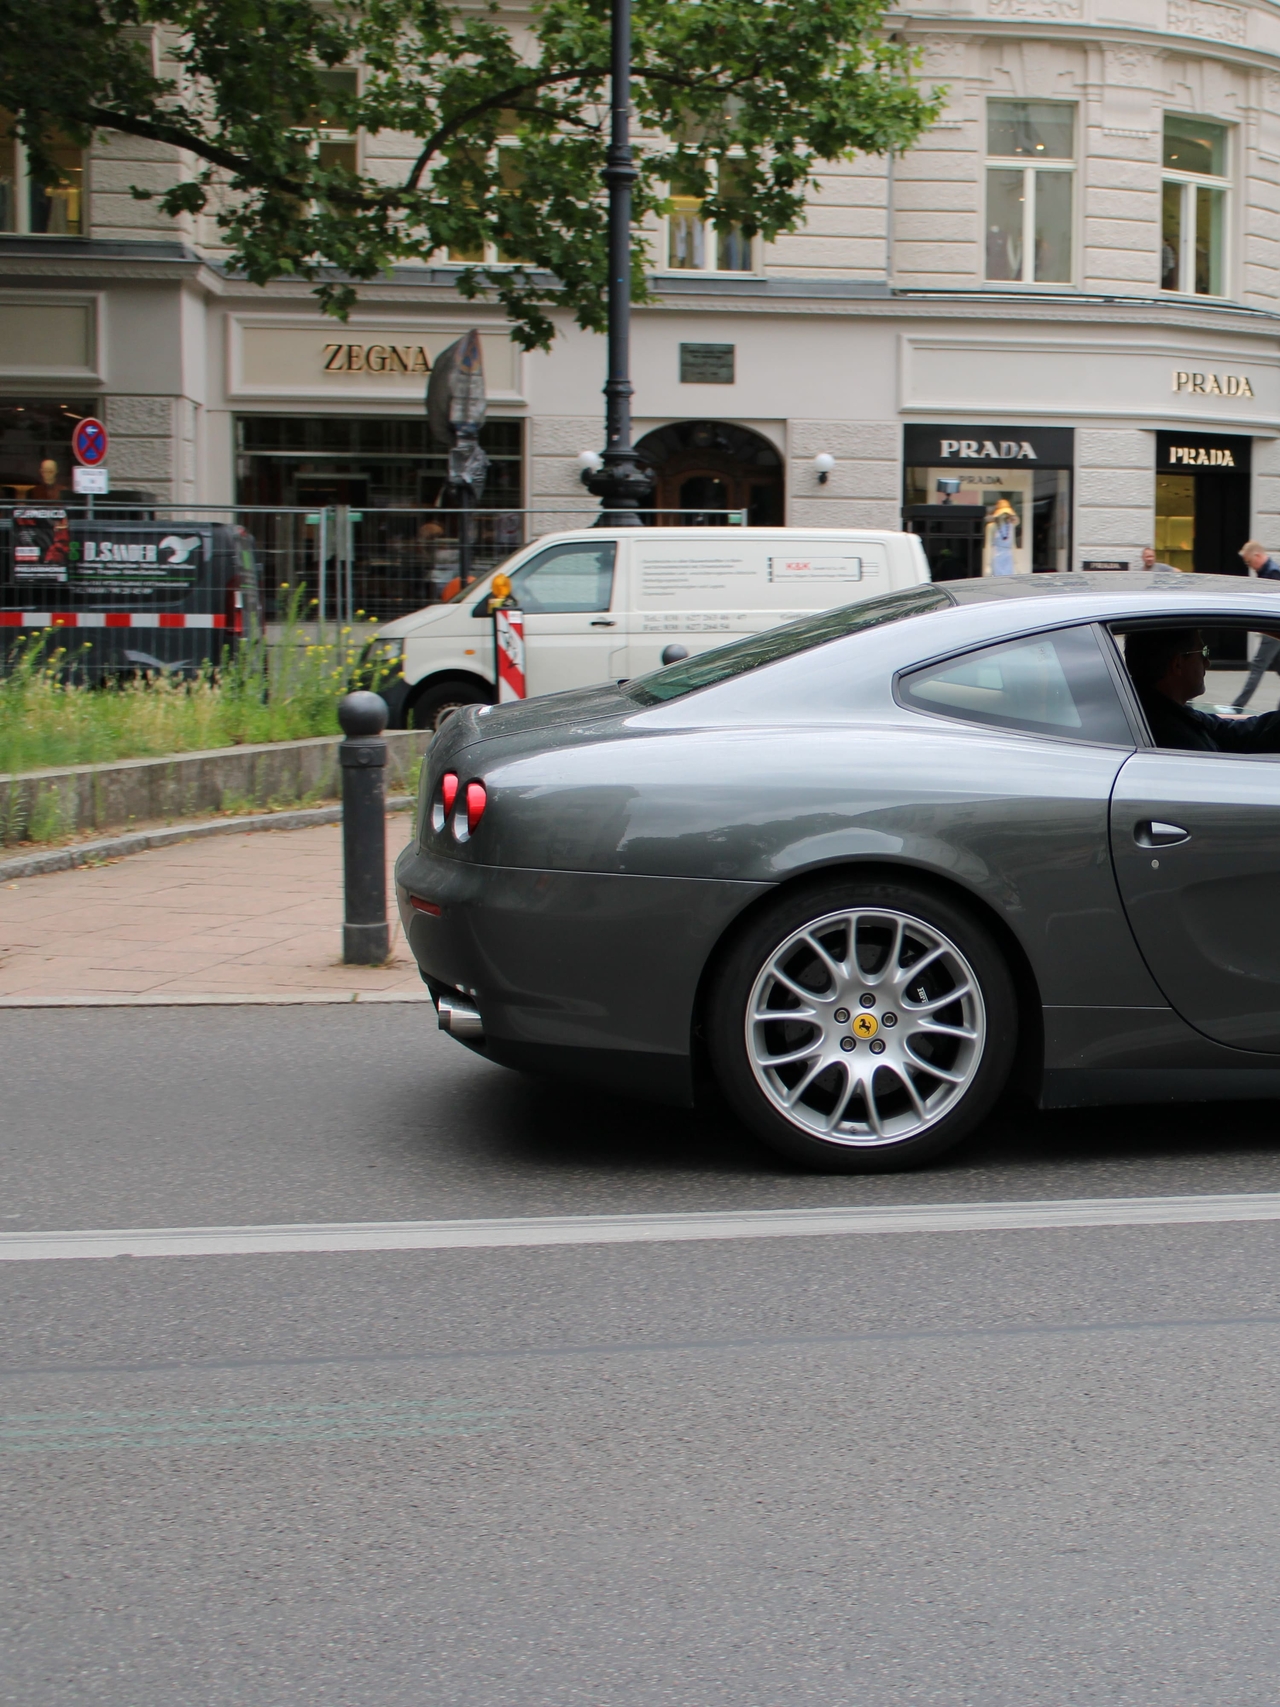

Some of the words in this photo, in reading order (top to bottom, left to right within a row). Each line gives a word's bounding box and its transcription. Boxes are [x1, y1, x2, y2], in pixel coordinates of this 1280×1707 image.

[323, 344, 432, 373] ZEGNA
[1172, 371, 1255, 398] PRADA
[940, 440, 1038, 459] PRADA
[1169, 446, 1235, 467] PRADA
